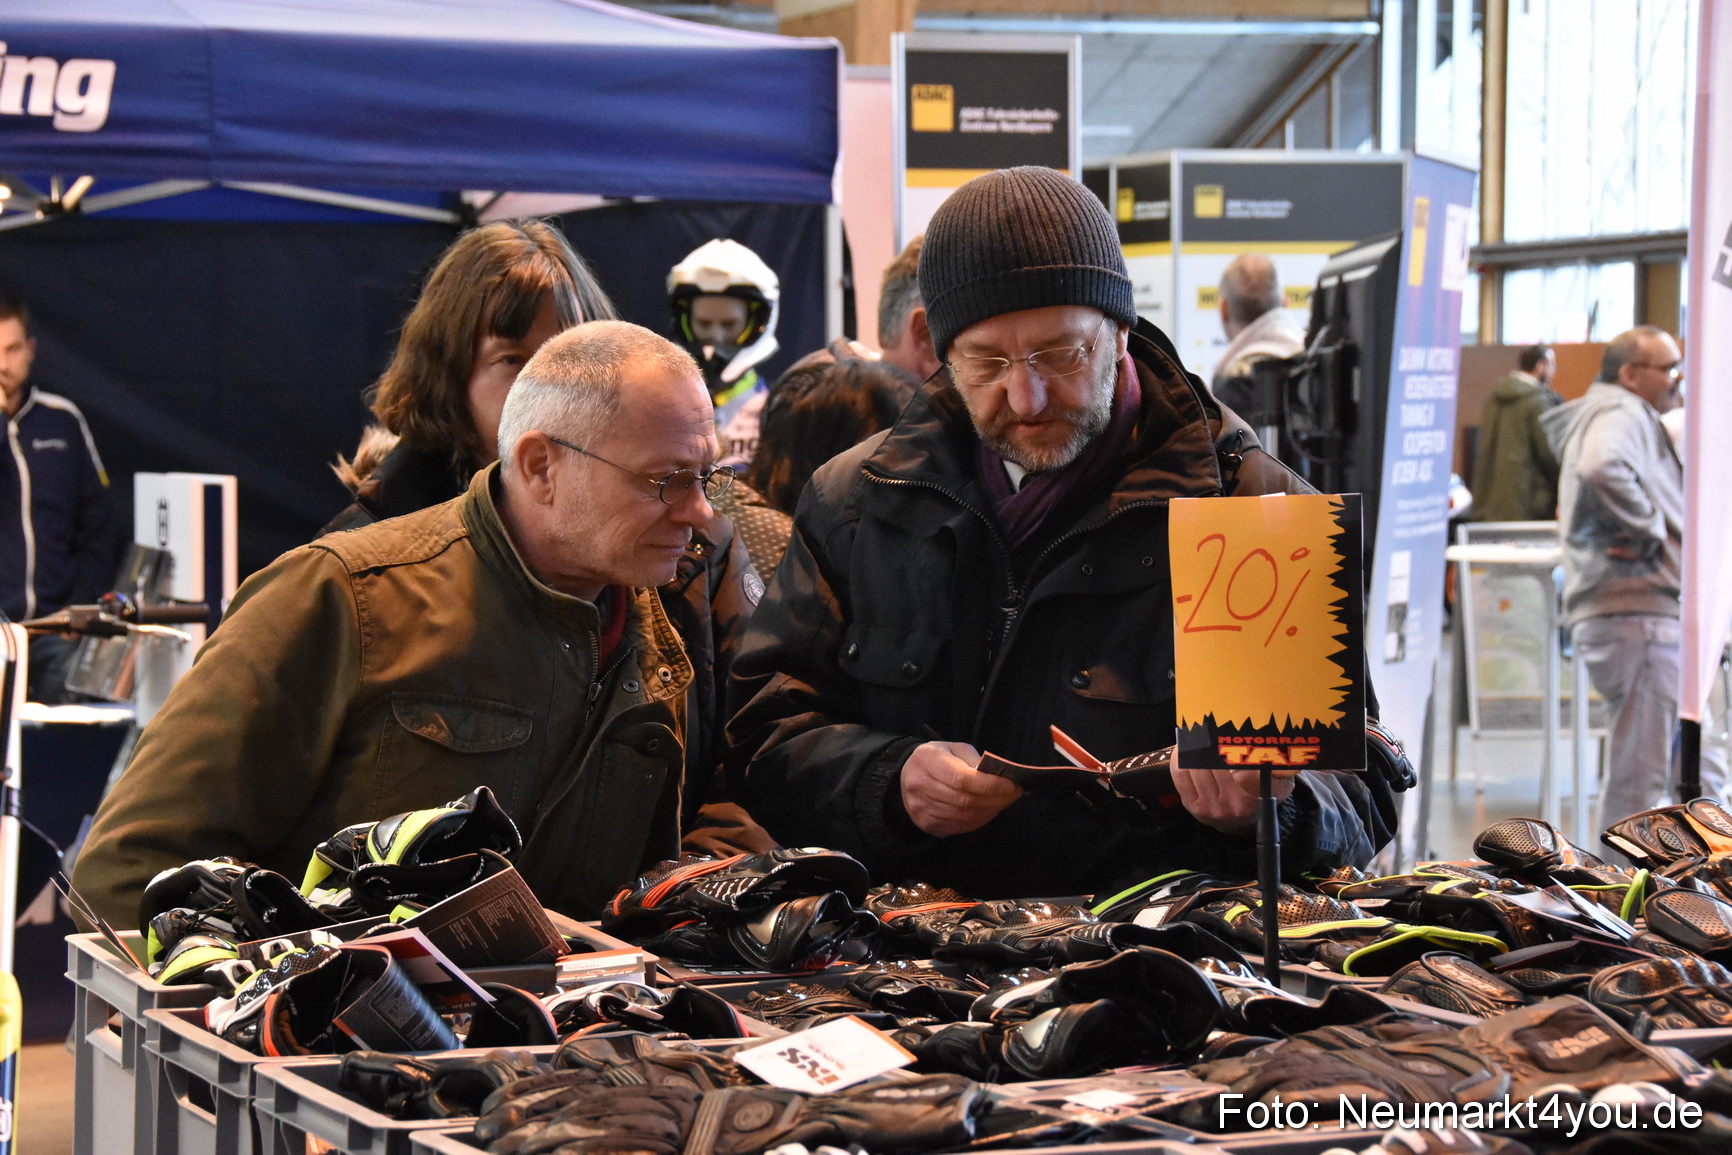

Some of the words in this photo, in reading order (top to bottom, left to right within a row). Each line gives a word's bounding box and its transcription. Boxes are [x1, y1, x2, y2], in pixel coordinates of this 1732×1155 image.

[1176, 533, 1311, 648] -20%
[1218, 736, 1320, 745] MOTORRAD
[1218, 744, 1320, 766] TAF
